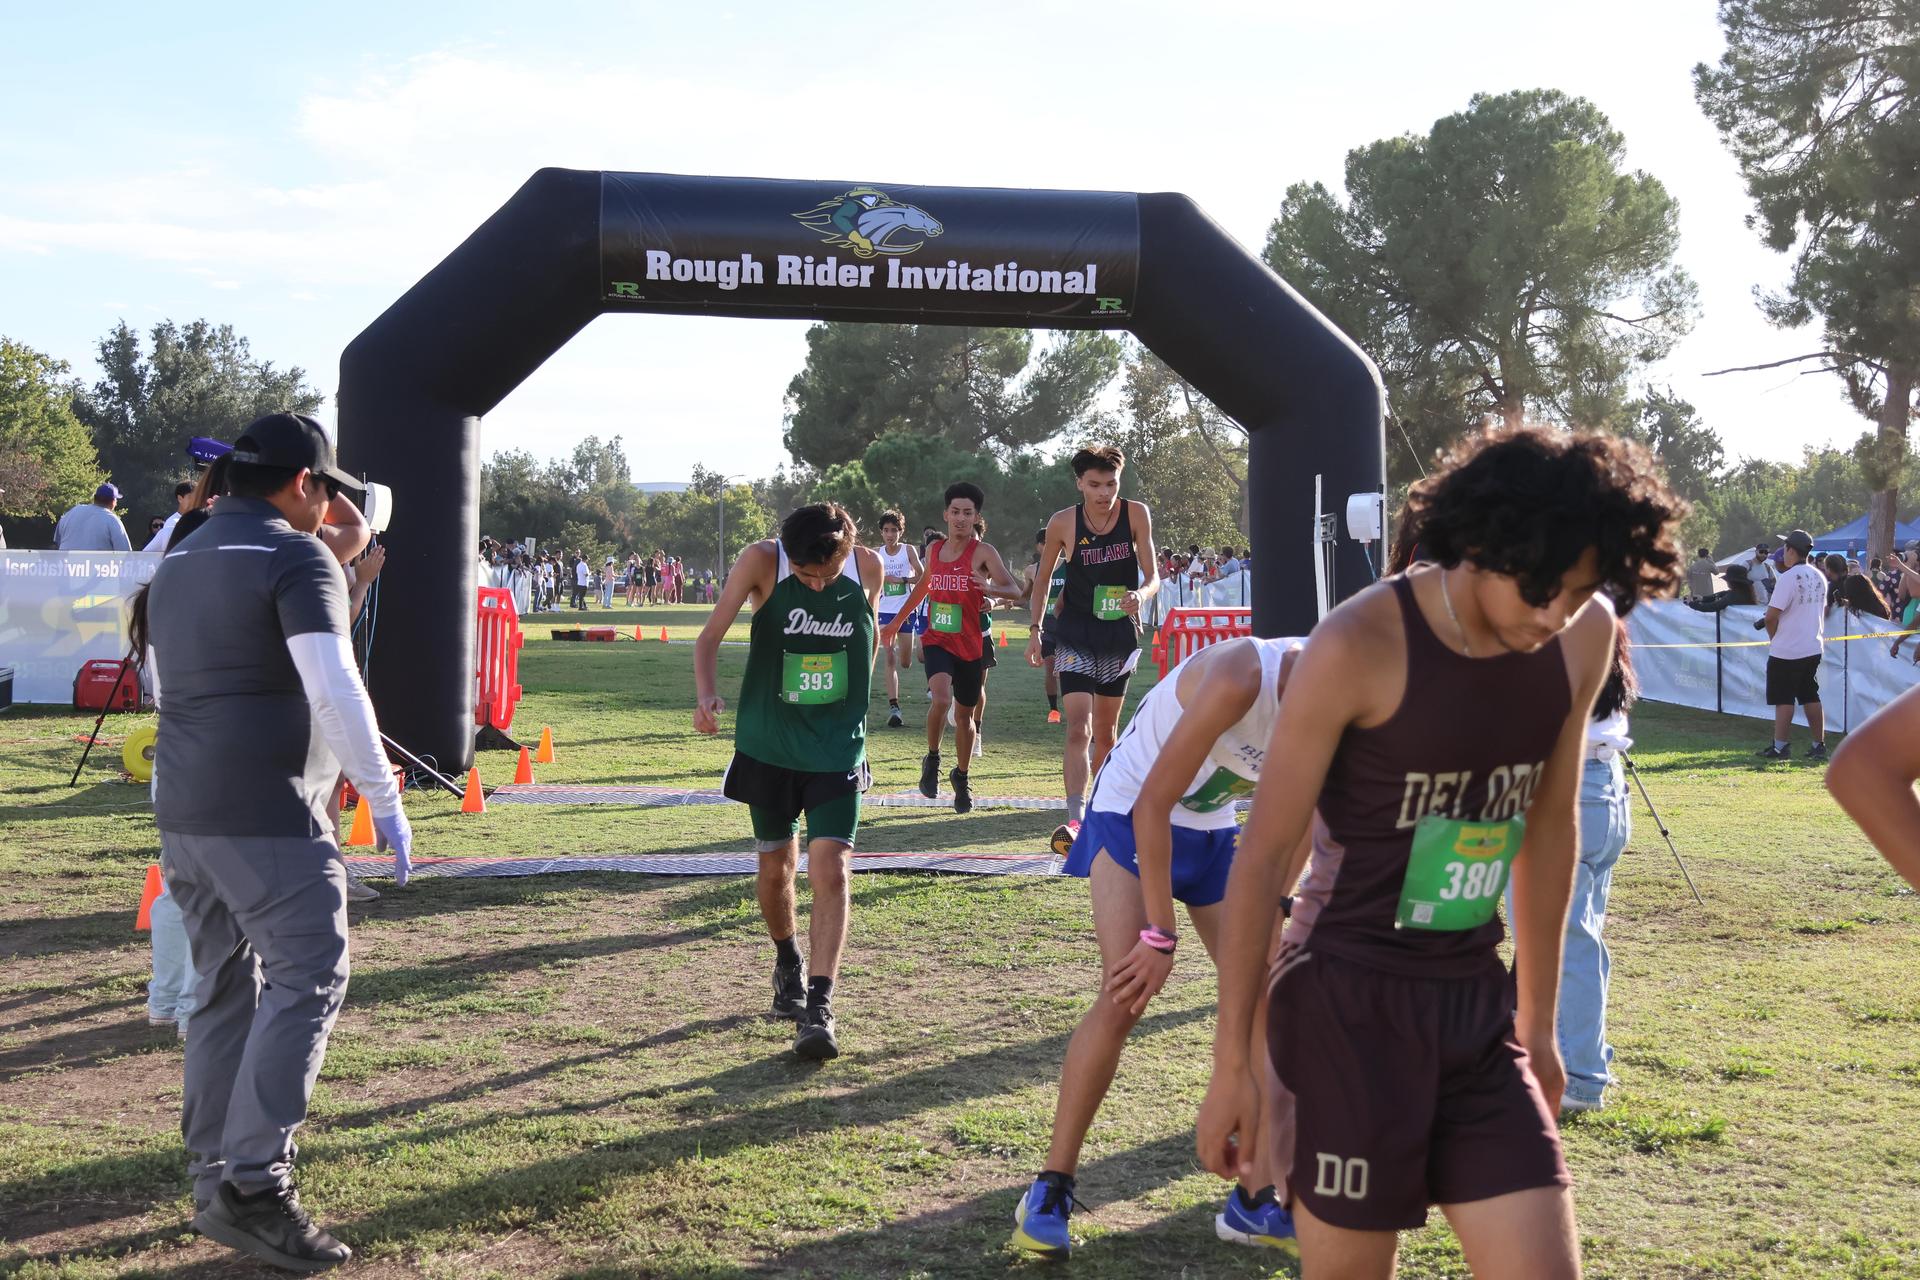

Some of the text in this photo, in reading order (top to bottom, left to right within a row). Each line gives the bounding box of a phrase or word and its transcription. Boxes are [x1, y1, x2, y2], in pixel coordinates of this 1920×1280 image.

[645, 249, 1097, 295] Rough Rider Invitational
[1080, 542, 1130, 566] TULARE
[935, 612, 952, 625] 281
[1101, 598, 1122, 611] 192
[783, 607, 854, 637] Dinuba
[799, 672, 833, 690] 393
[1395, 771, 1472, 829] DEL
[1439, 859, 1504, 900] 380
[1313, 1151, 1369, 1199] DO
